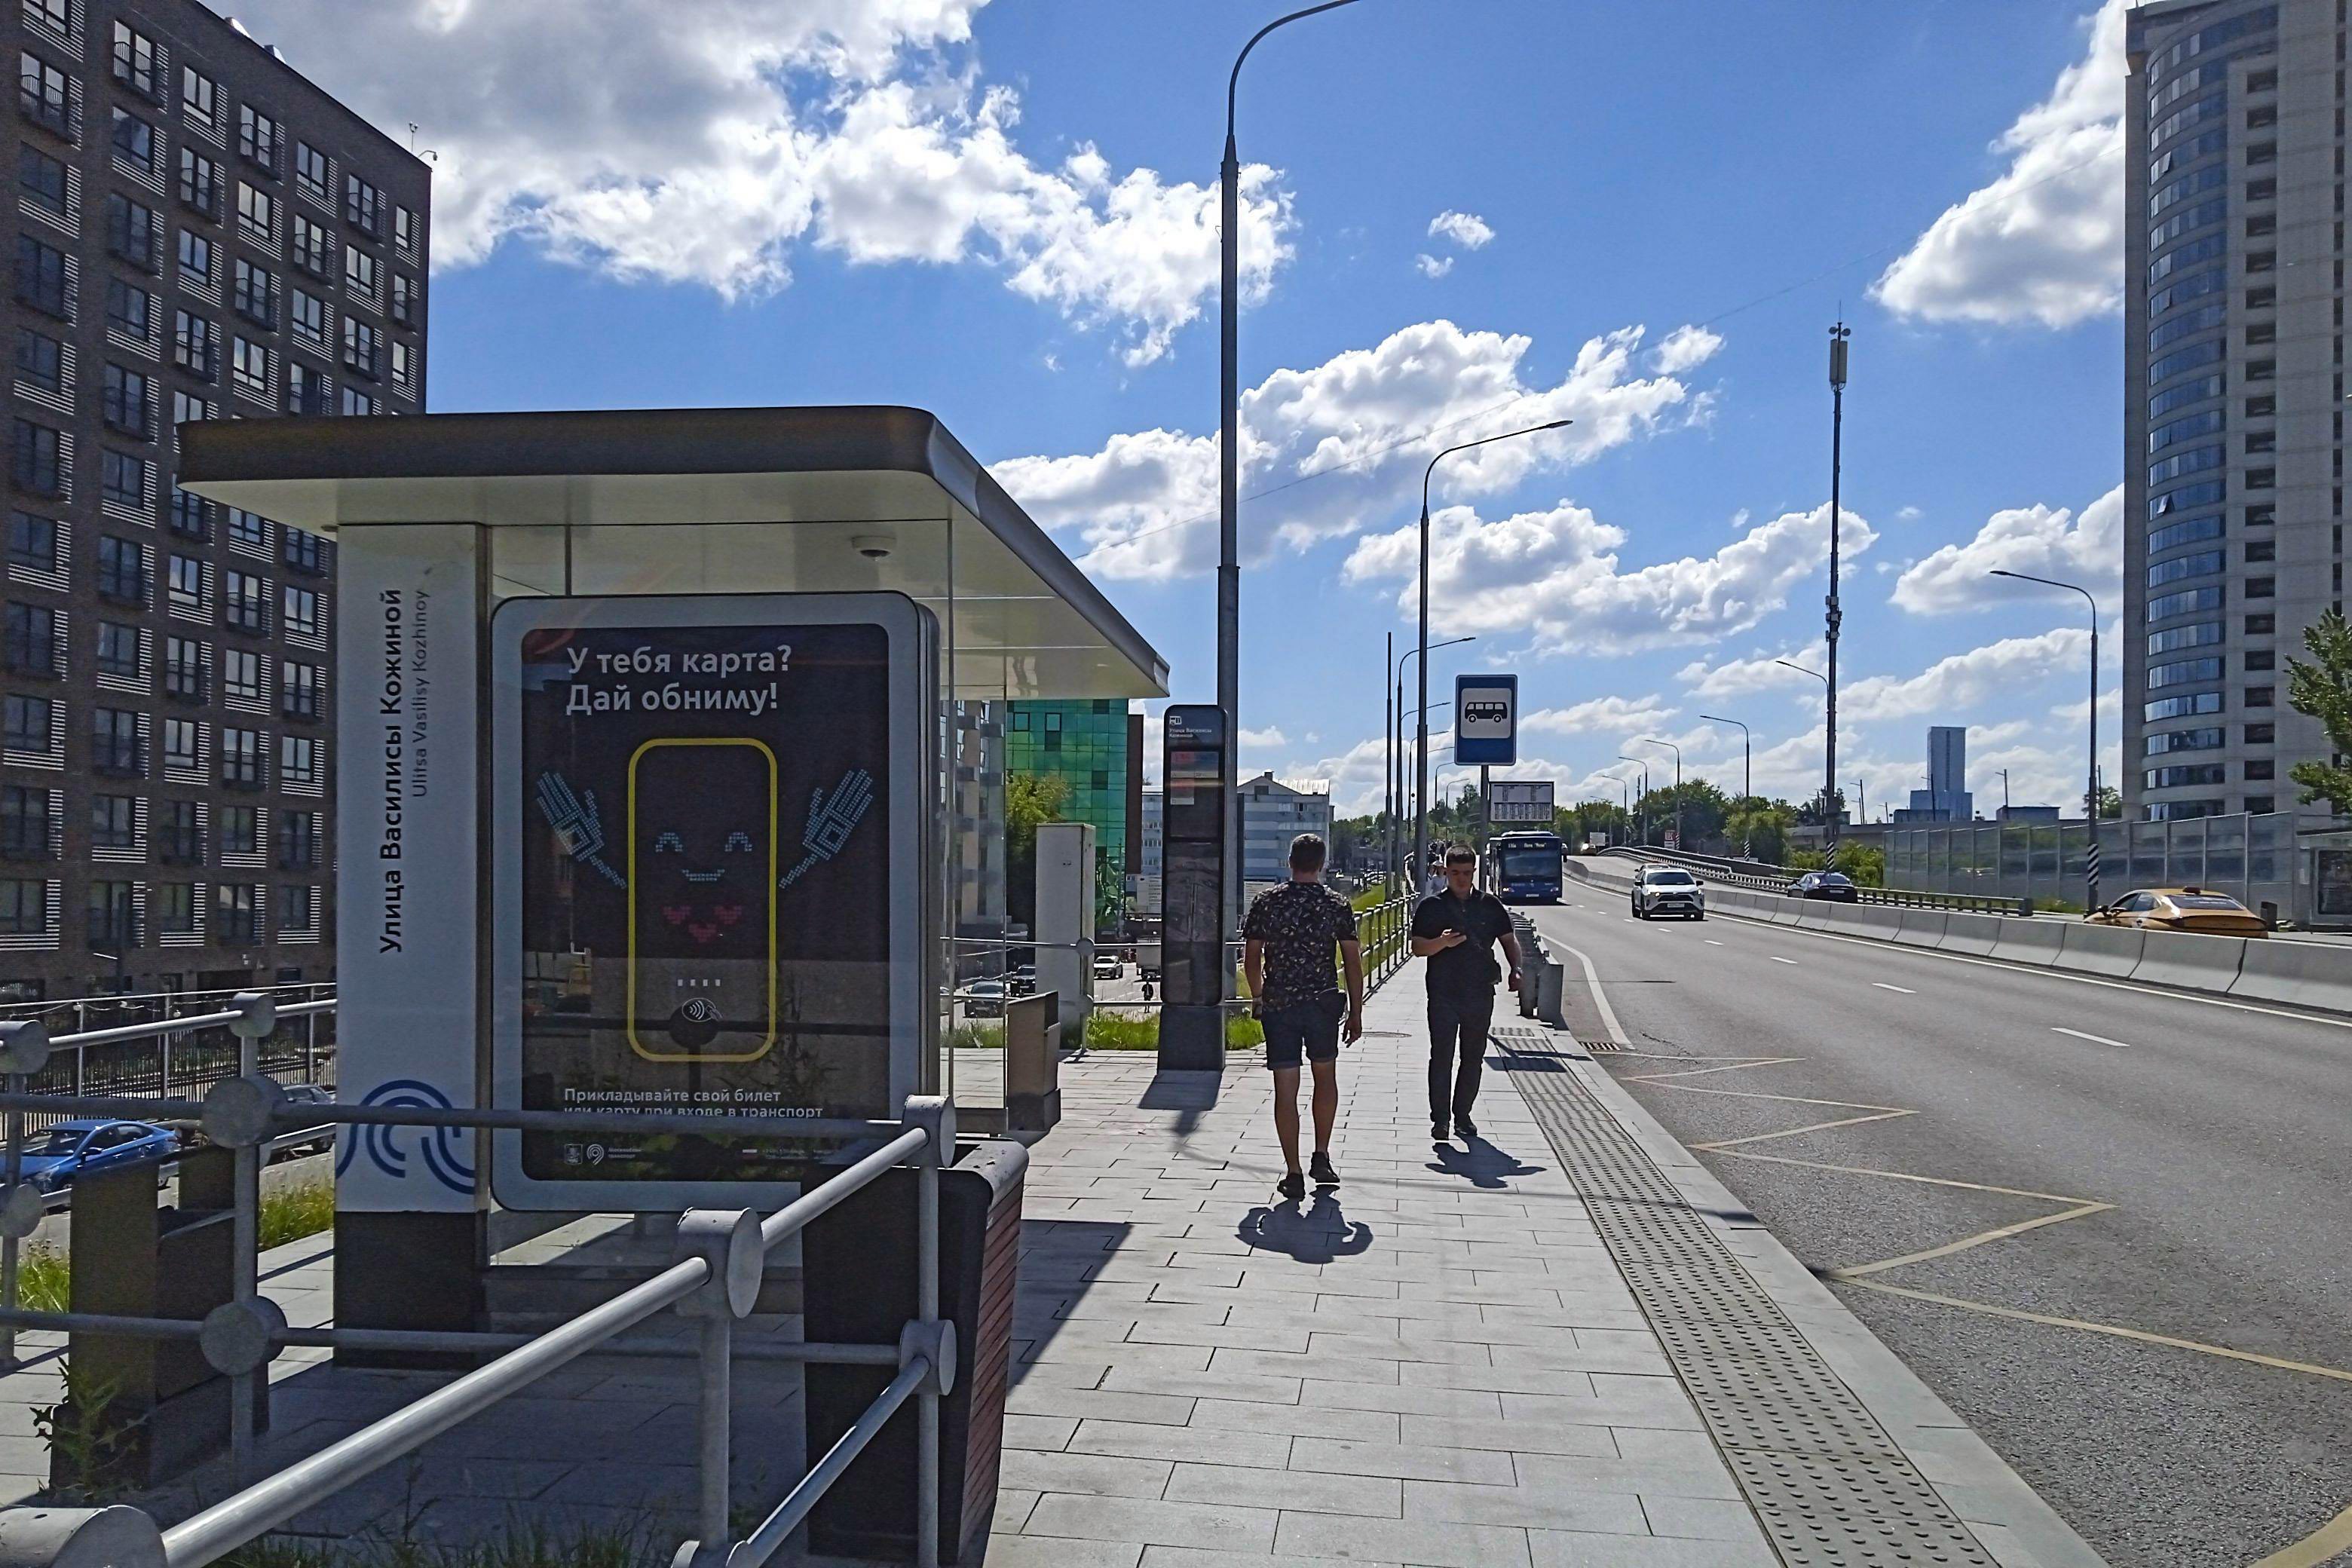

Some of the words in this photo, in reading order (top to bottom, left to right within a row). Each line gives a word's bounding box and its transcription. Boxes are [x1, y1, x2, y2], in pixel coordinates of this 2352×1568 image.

[379, 589, 403, 715] Кожиной
[412, 590, 431, 672] Kozhinoy
[566, 647, 589, 675] У
[597, 646, 671, 674] тебя
[683, 645, 792, 678] карта?
[412, 677, 431, 744] Vasilisy
[566, 684, 630, 715] Дай
[642, 682, 777, 715] обниму!
[379, 724, 403, 860] Василисы
[412, 749, 428, 798] Ulitsa
[379, 869, 405, 954] Улица
[565, 1088, 689, 1104] Прикладывайте
[694, 1089, 730, 1102] свой
[734, 1089, 781, 1102] билет
[741, 1108, 823, 1119] транспорт
